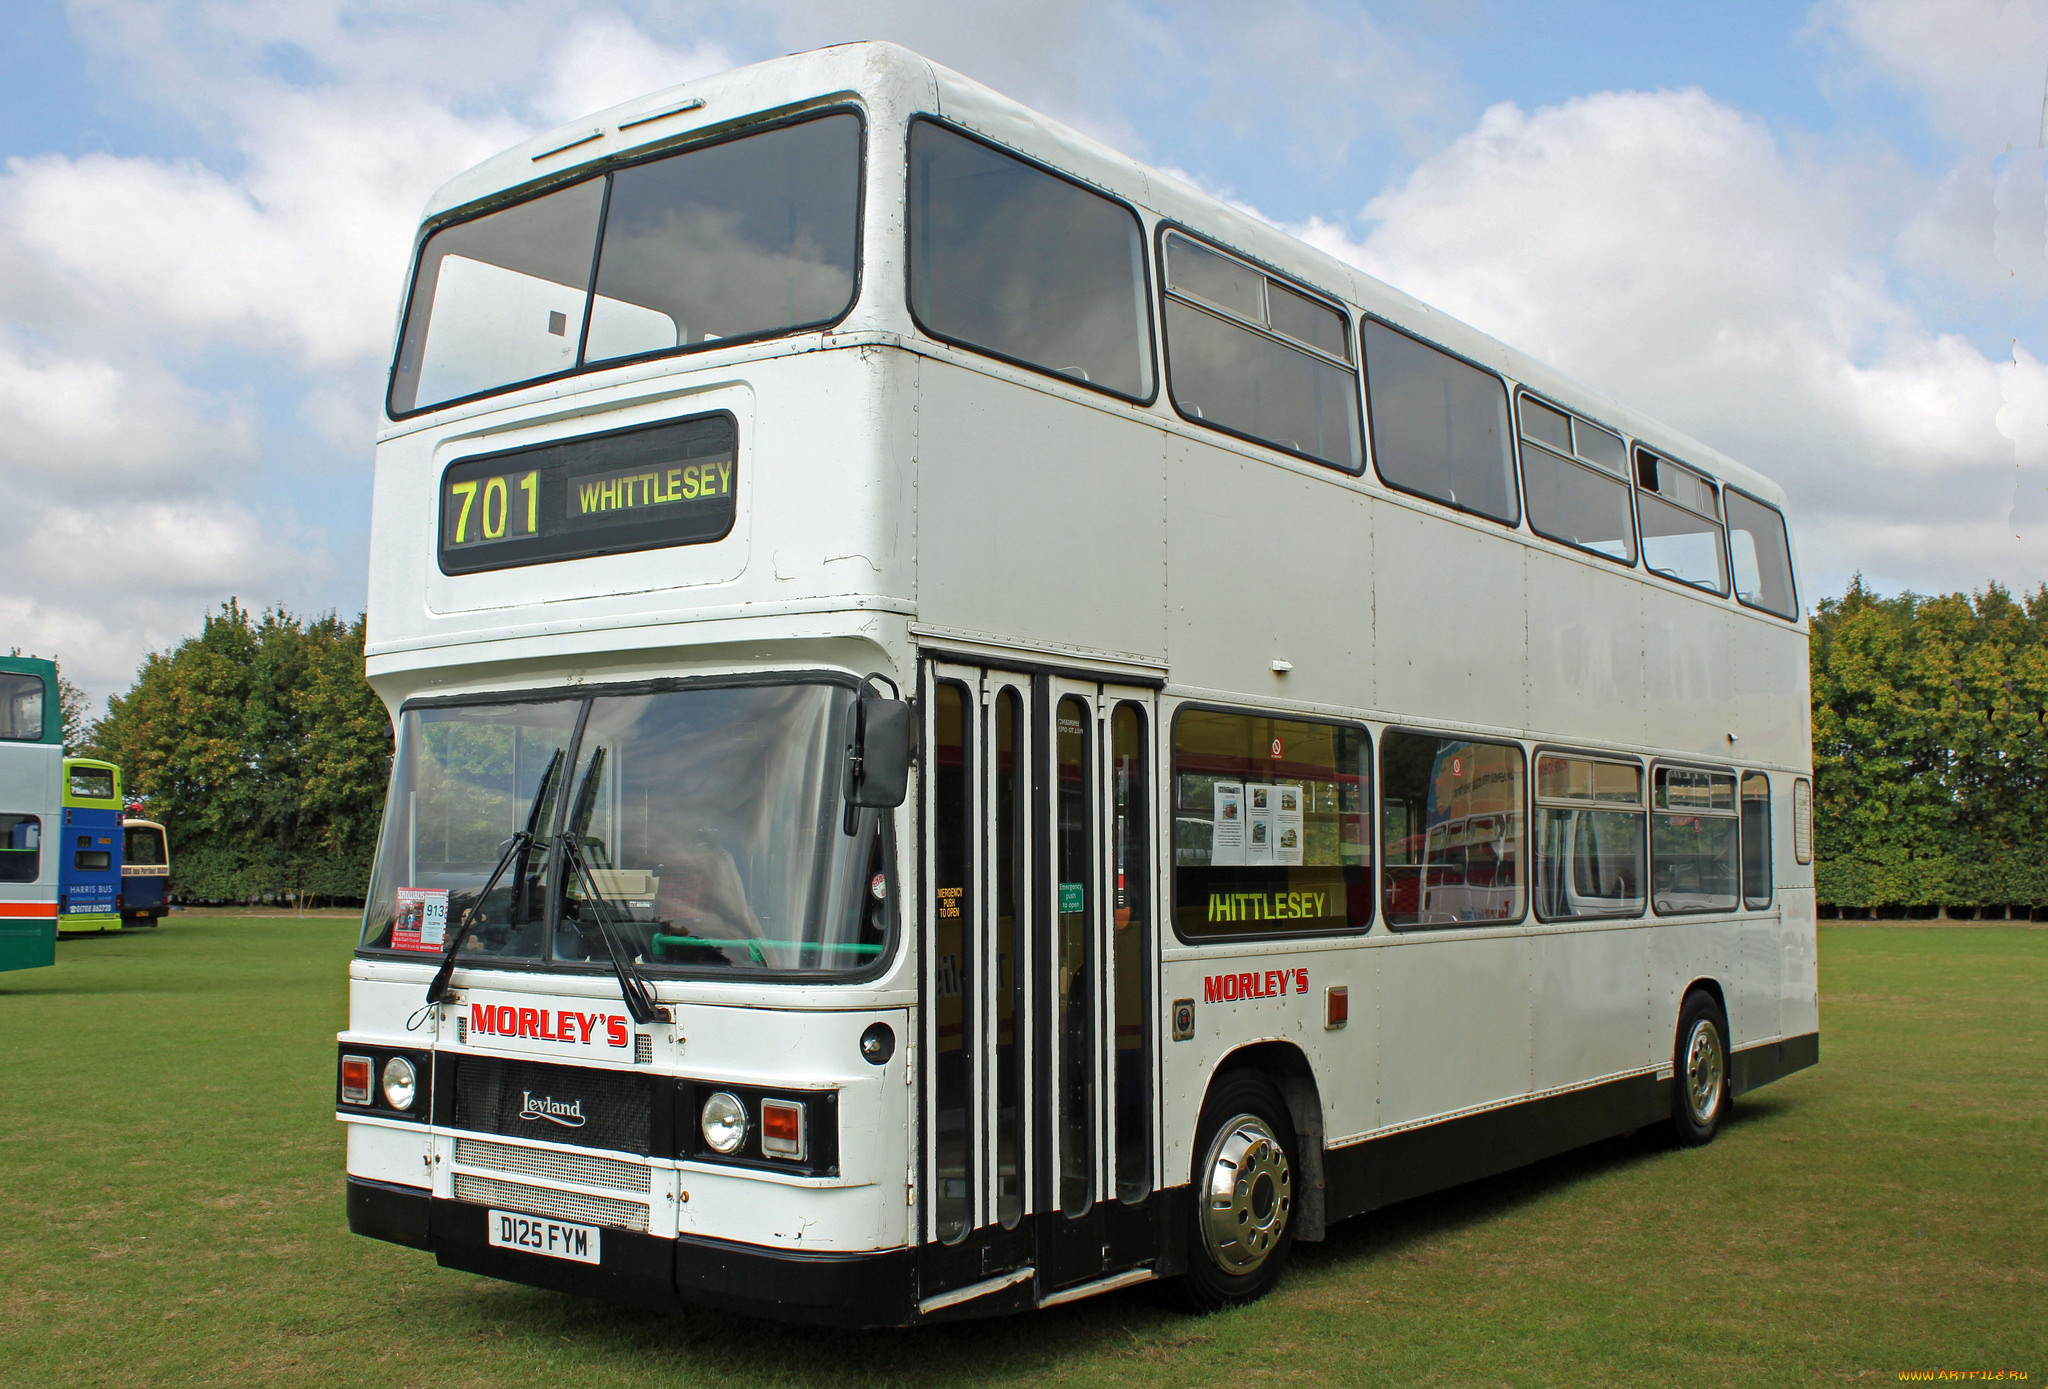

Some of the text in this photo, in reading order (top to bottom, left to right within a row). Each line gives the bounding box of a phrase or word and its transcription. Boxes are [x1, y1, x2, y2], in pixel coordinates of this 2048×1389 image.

[578, 460, 732, 514] WHITTLESEY
[452, 470, 539, 544] 701
[70, 885, 112, 893] HARRIS BUS
[1060, 883, 1082, 891] Emergency
[399, 891, 425, 900] SHOWBUS
[1065, 892, 1077, 900] push
[943, 898, 956, 908] PUSH
[427, 904, 445, 917] 913
[939, 907, 960, 918] TO OPEN
[1204, 968, 1309, 1004] MORLEY'S
[470, 1003, 628, 1048] MORLEY'S
[519, 1091, 586, 1127] Leyland
[501, 1216, 588, 1257] D125 FYM
